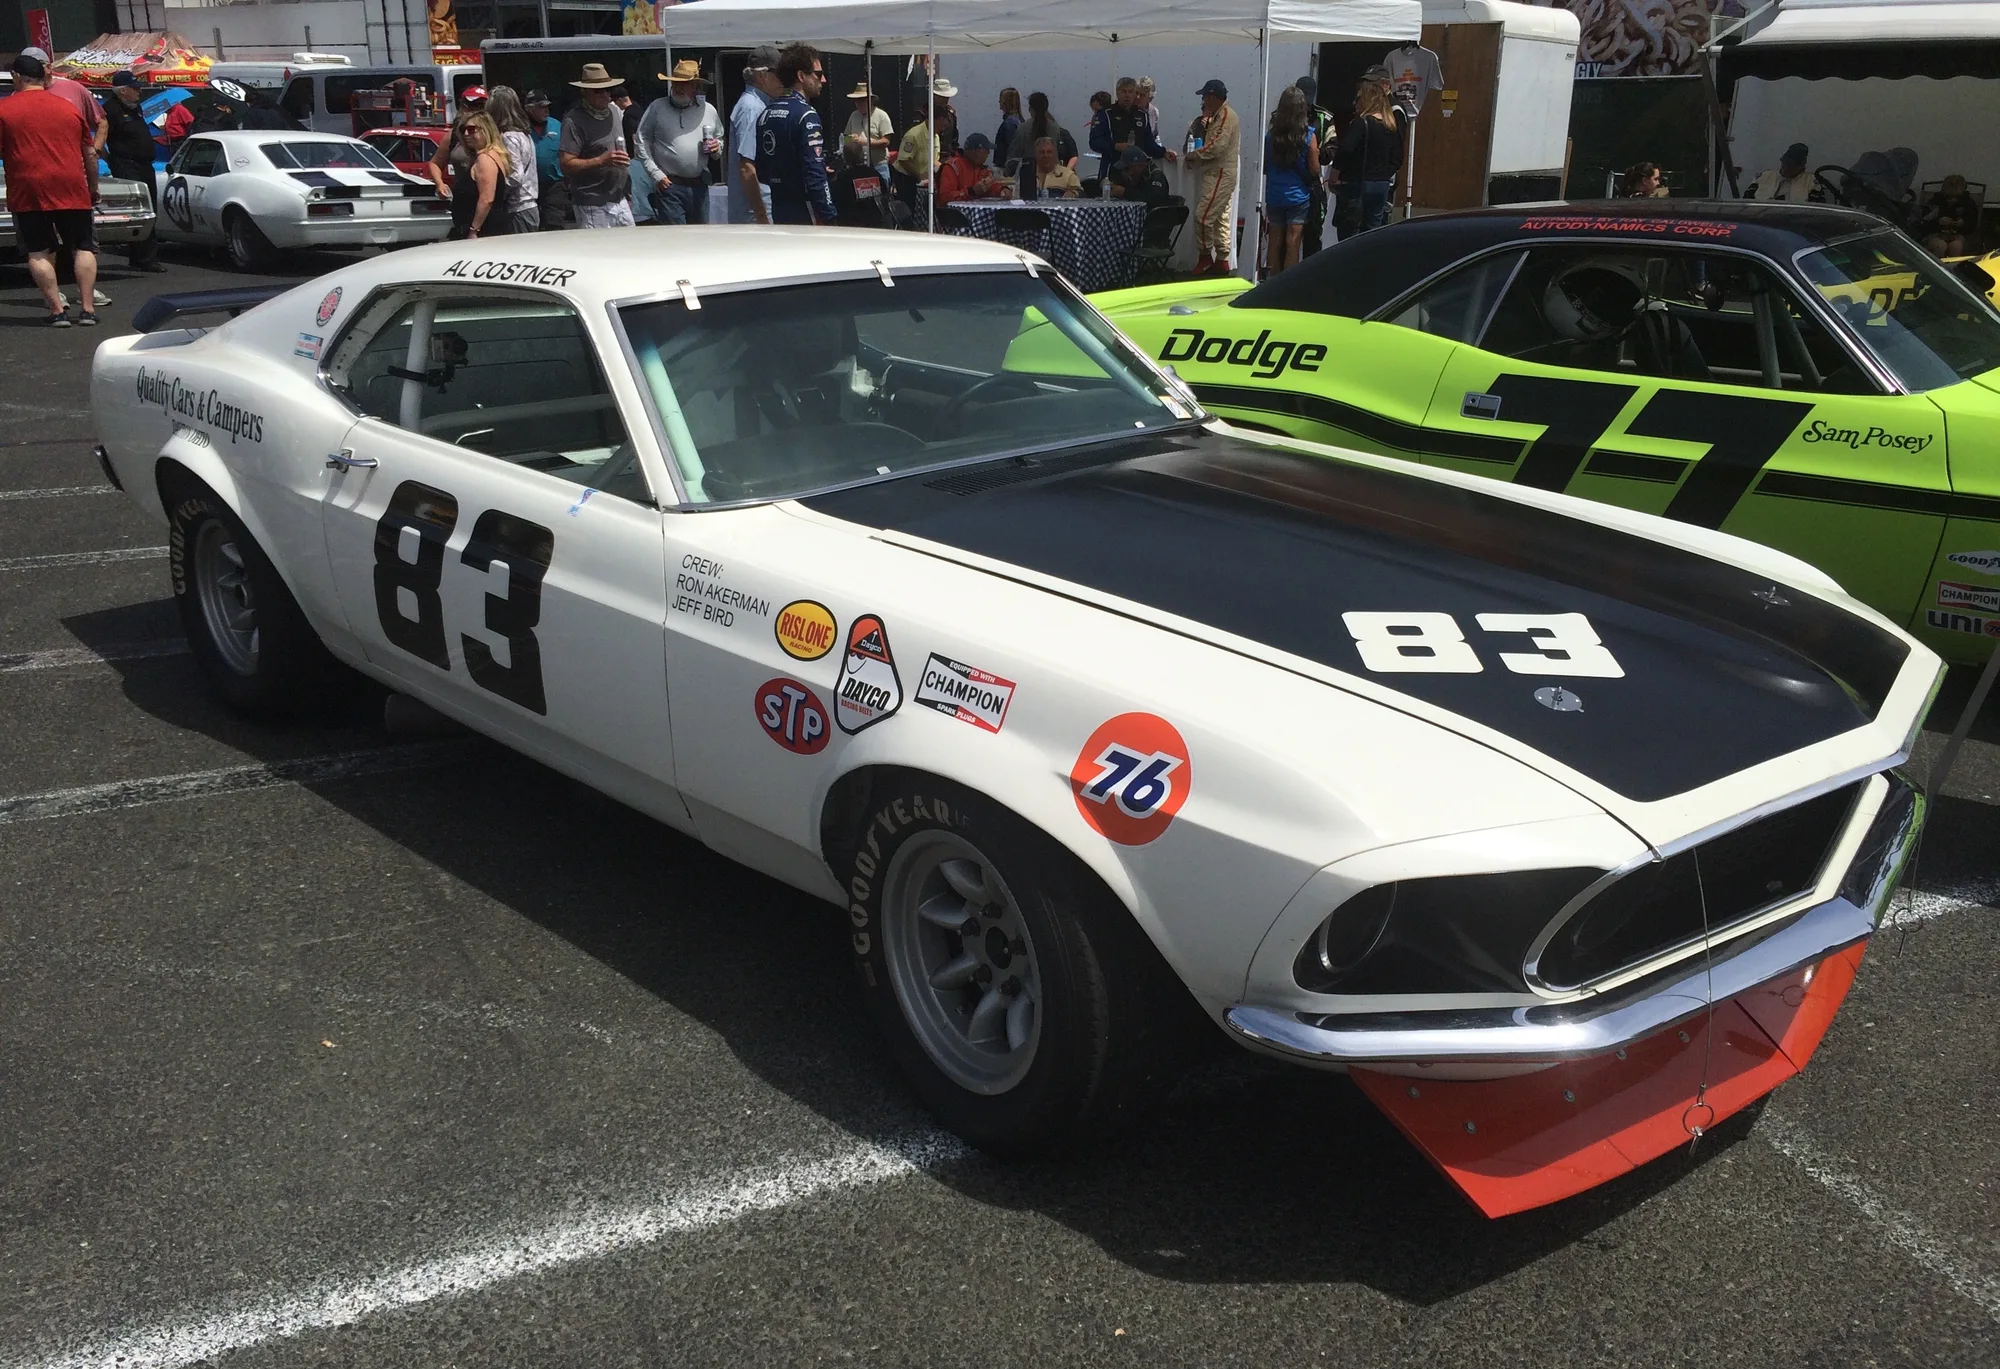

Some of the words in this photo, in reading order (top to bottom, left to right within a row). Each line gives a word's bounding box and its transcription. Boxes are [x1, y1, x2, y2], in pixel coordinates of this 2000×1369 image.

[155, 74, 174, 82] CURLY
[175, 74, 192, 82] FRIES
[166, 186, 189, 223] 30
[1519, 221, 1667, 233] AUTODYNAMICS
[1673, 224, 1732, 238] CORP.
[442, 260, 472, 277] AL
[473, 261, 577, 287] COSTNER
[1158, 328, 1328, 379] Dodge
[136, 365, 171, 416] Quality
[171, 376, 196, 418] Cars
[196, 391, 205, 422] &
[206, 388, 264, 443] Campers
[1484, 373, 1817, 531] 77
[1802, 420, 1860, 449] Sam
[1860, 426, 1933, 454] Posey
[682, 554, 724, 579] CREW:
[373, 479, 555, 717] 83
[672, 595, 702, 616] JEFF
[703, 604, 735, 628] BIRD
[676, 573, 705, 596] RON
[704, 583, 770, 617] AKERMAN
[1941, 589, 1998, 606] CHAMPION
[779, 612, 832, 650] RISLONE
[789, 641, 813, 654] RACING
[860, 639, 882, 653] Dayco
[1341, 611, 1626, 679] 83
[949, 661, 979, 677] EQUIPPED
[980, 671, 996, 683] WITH
[841, 677, 891, 711] DAYCO
[841, 699, 859, 712] RACING
[858, 704, 873, 717] BELTS
[925, 670, 1005, 714] CHAMPION
[762, 685, 823, 745] STP
[936, 703, 957, 716] SPARK
[955, 711, 977, 724] PLUGS
[1086, 746, 1172, 815] 76
[851, 795, 953, 955] GOODYEAR
